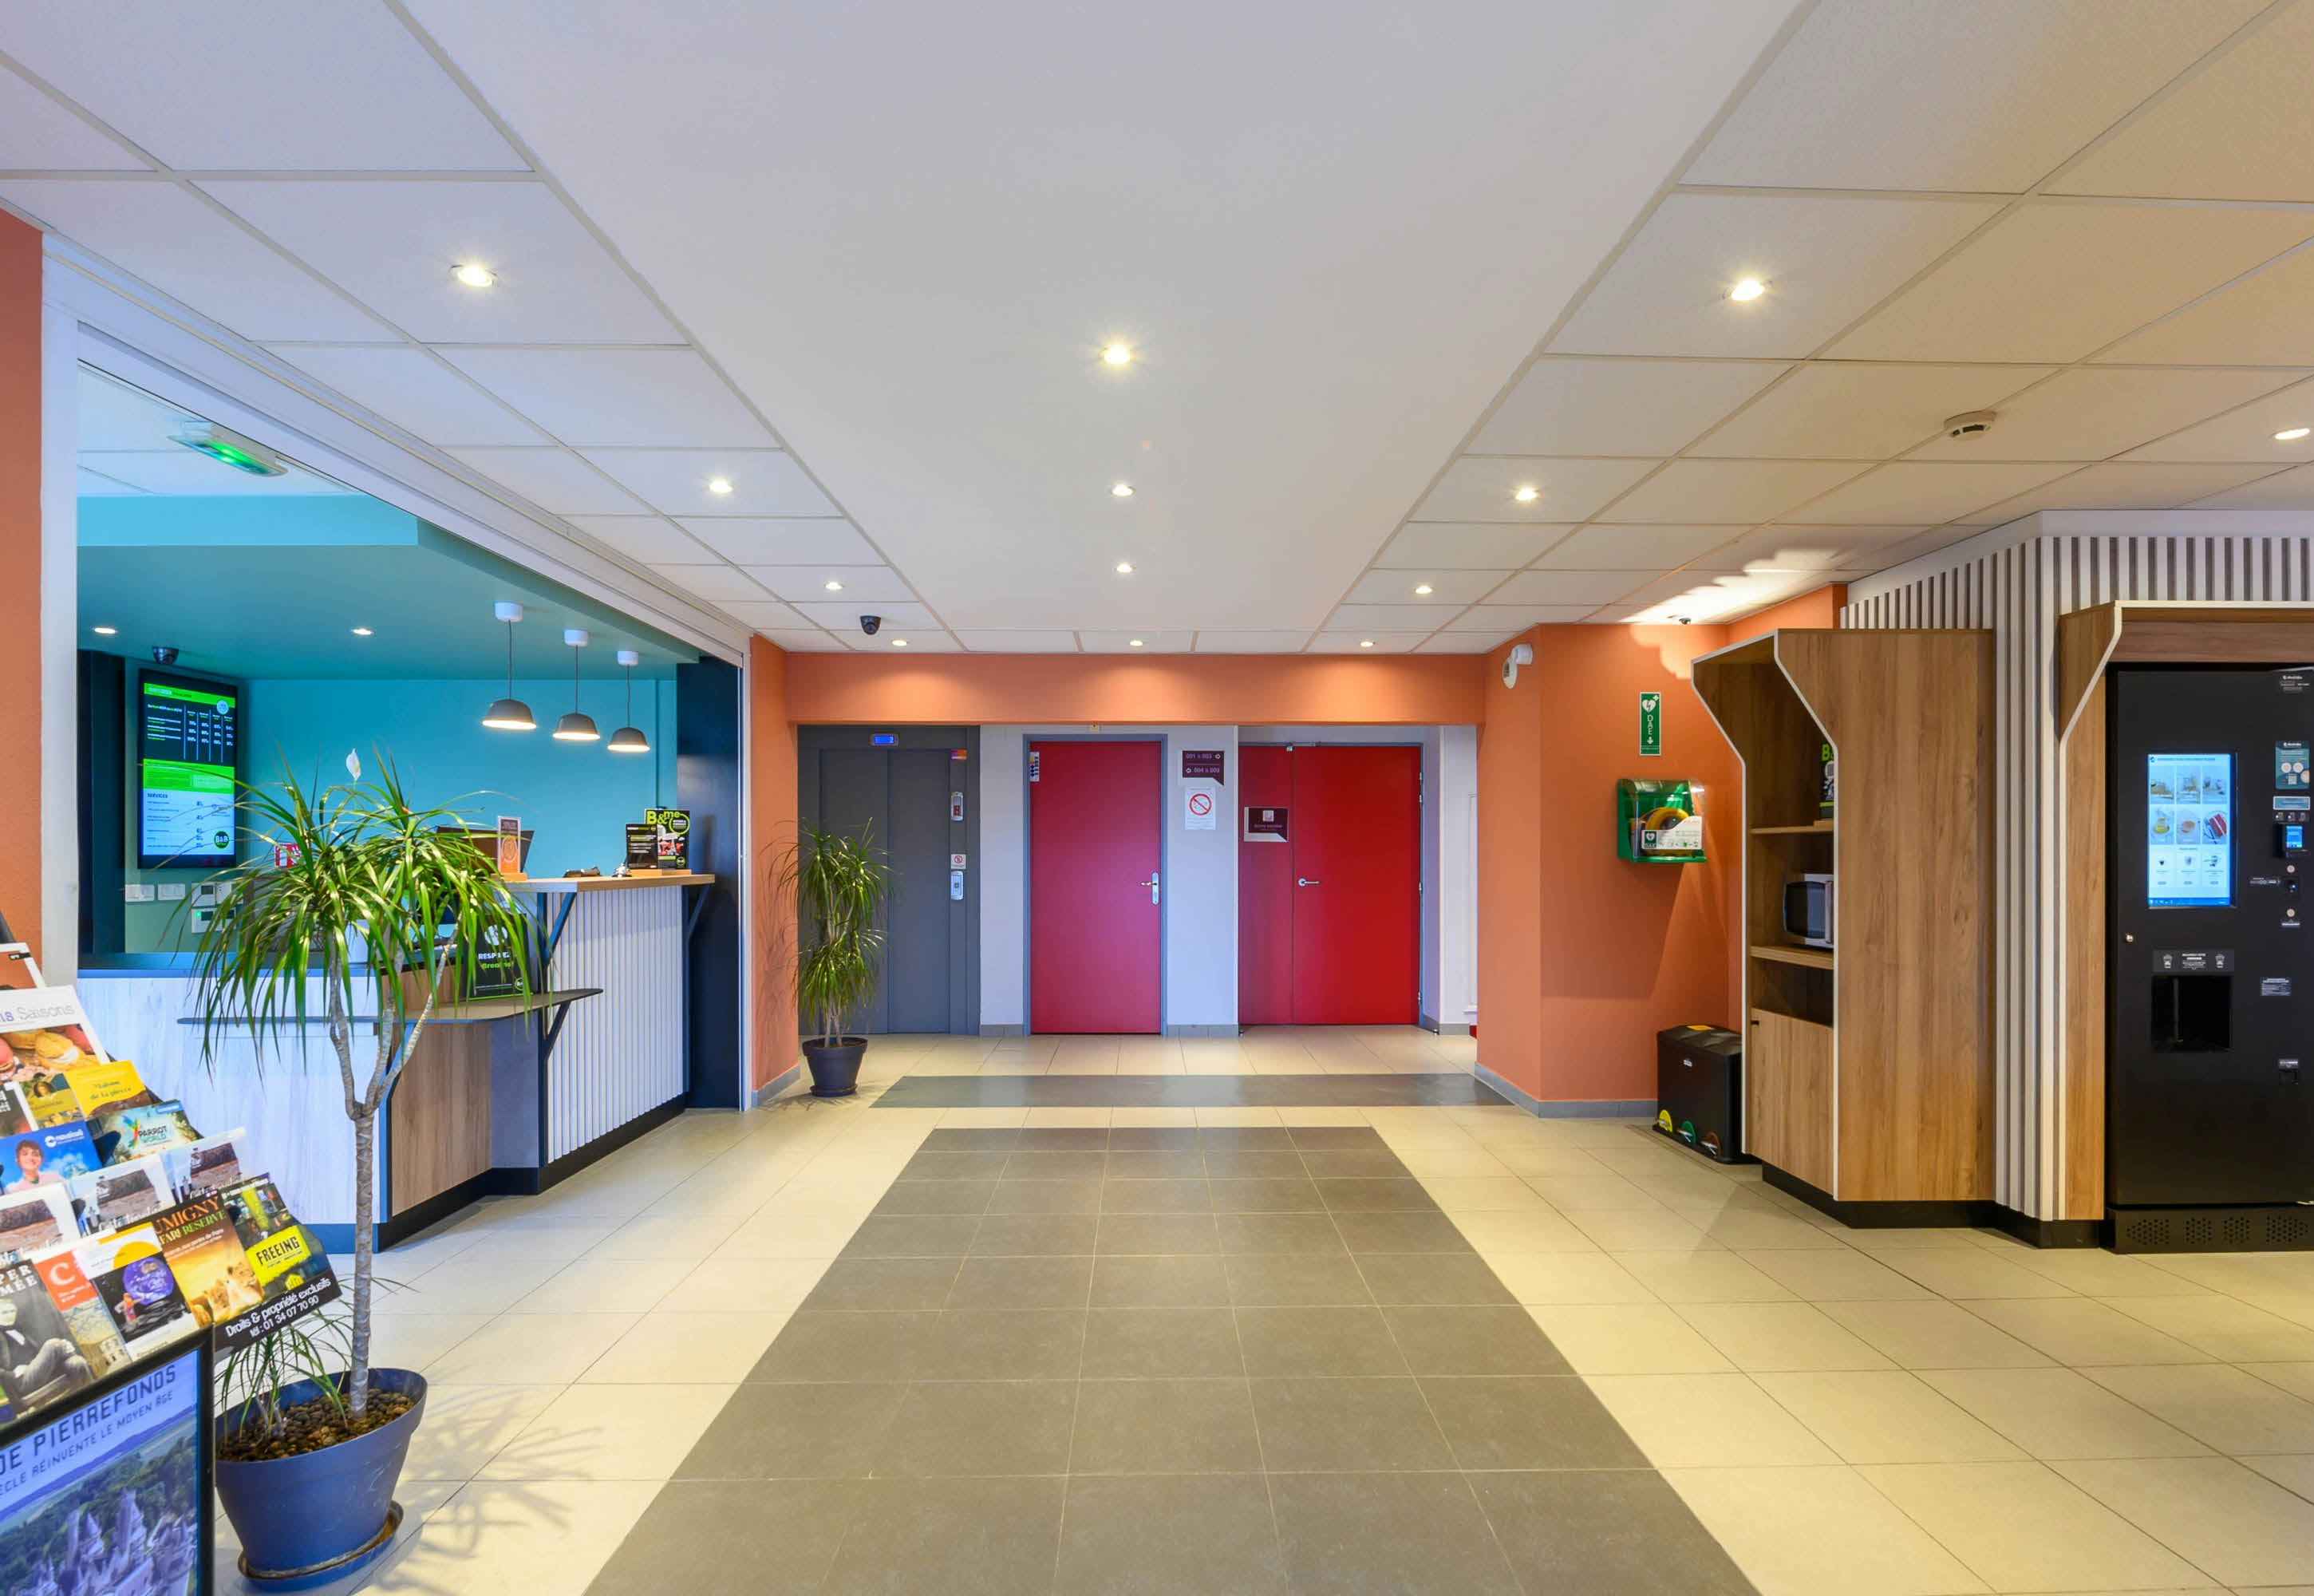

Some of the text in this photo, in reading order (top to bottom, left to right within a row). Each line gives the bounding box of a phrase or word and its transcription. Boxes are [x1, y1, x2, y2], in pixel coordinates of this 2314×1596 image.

[139, 1126, 167, 1136] PARROT
[141, 1133, 167, 1143] WORLD
[154, 1196, 219, 1235] UMIGNY
[159, 1228, 182, 1245] FARI
[255, 1236, 300, 1266] FREEING
[49, 1262, 76, 1286] C
[225, 1277, 332, 1338] Droits & propriété exclusifs
[263, 1319, 274, 1330] 01
[274, 1313, 286, 1325] 34
[286, 1306, 298, 1317] 07
[297, 1301, 308, 1312] 70
[307, 1295, 319, 1306] 90
[34, 1365, 176, 1456] PIERREFONDS
[101, 1424, 113, 1439] LE
[117, 1402, 152, 1430] MOYEN
